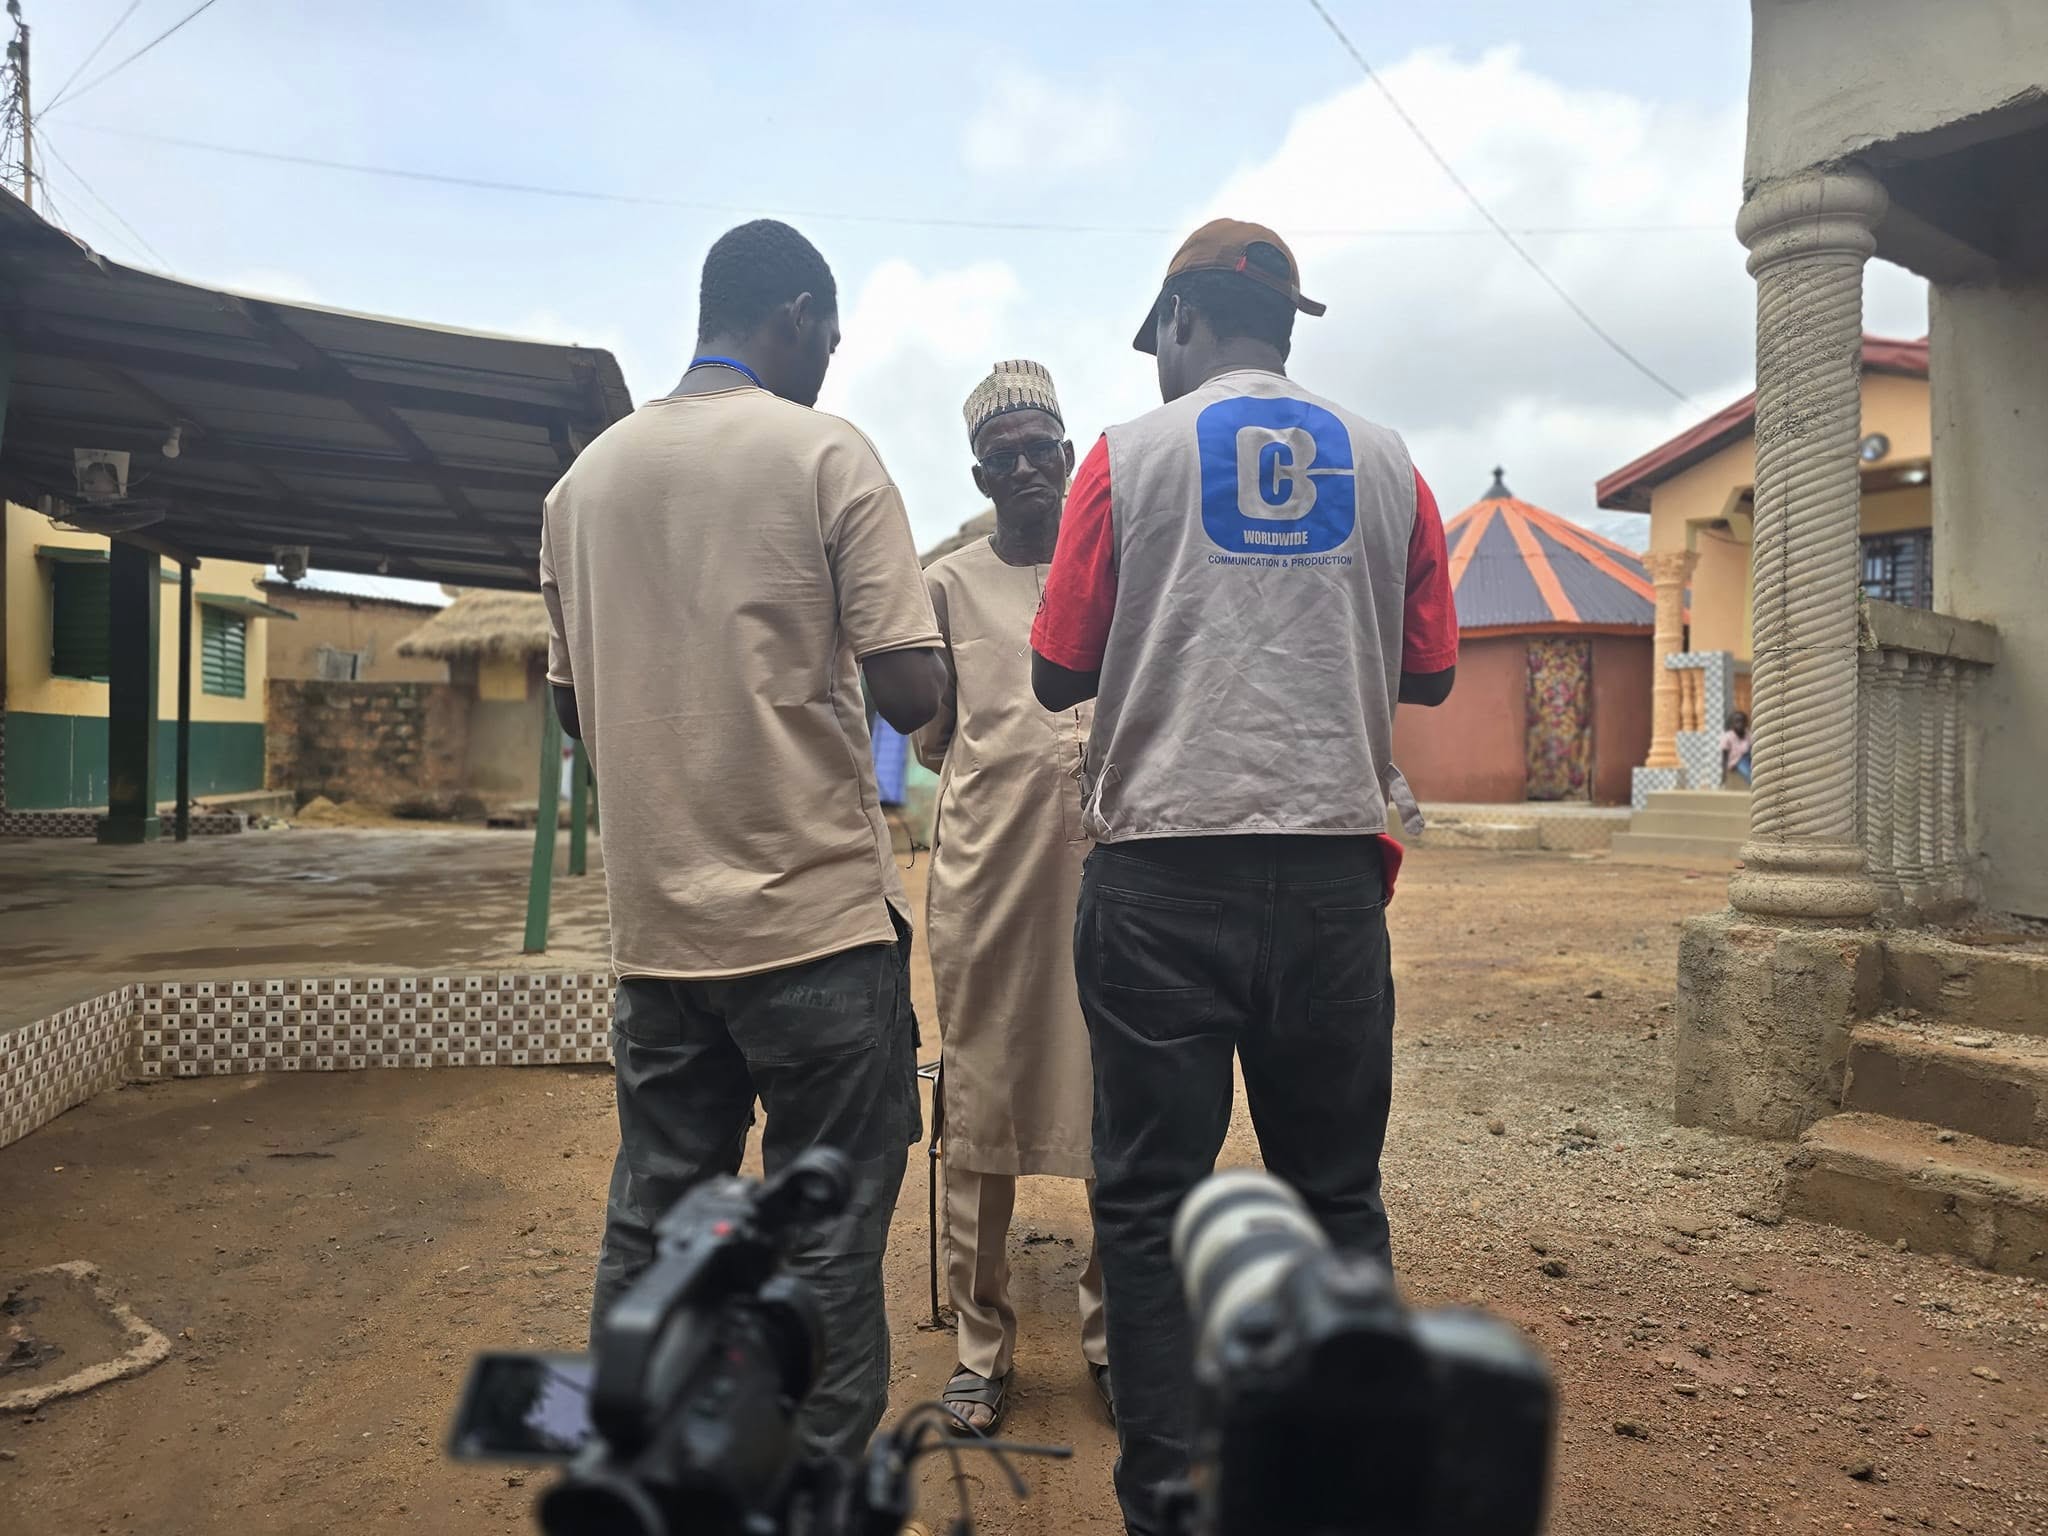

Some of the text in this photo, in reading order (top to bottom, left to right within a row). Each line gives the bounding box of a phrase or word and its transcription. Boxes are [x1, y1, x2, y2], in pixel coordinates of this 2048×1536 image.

[1243, 530, 1309, 546] WORLDWIDE
[1208, 554, 1353, 568] COMMUNICATION & PRODUCTION
